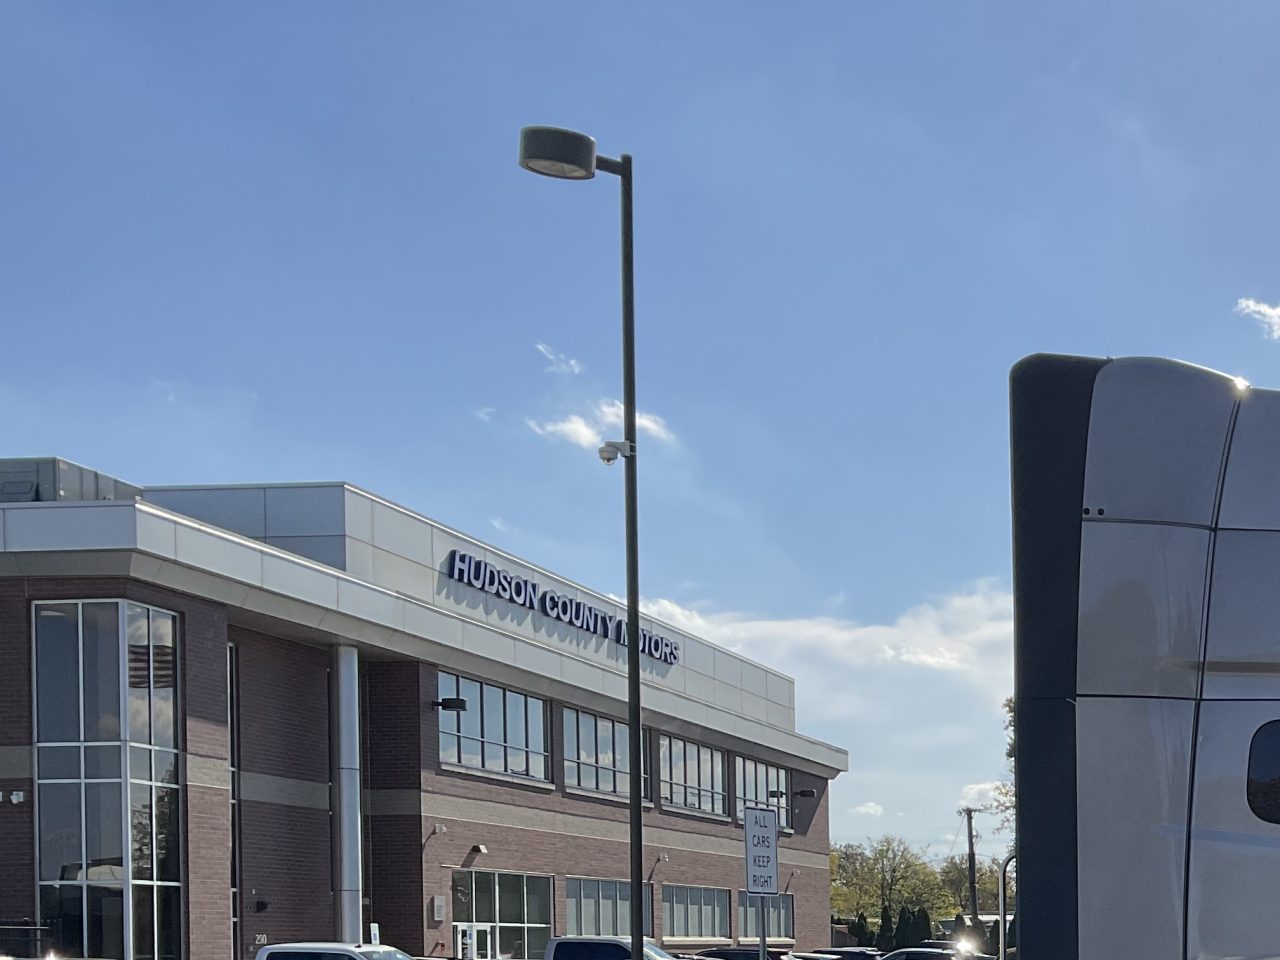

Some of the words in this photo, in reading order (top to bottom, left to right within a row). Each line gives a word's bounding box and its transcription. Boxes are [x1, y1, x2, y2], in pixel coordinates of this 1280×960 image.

[449, 549, 539, 610] HUDSON
[541, 589, 617, 640] COUNTY
[753, 815, 768, 828] ALL
[752, 834, 770, 849] CARS
[752, 855, 771, 868] KEEP
[752, 875, 772, 888] RIGHT
